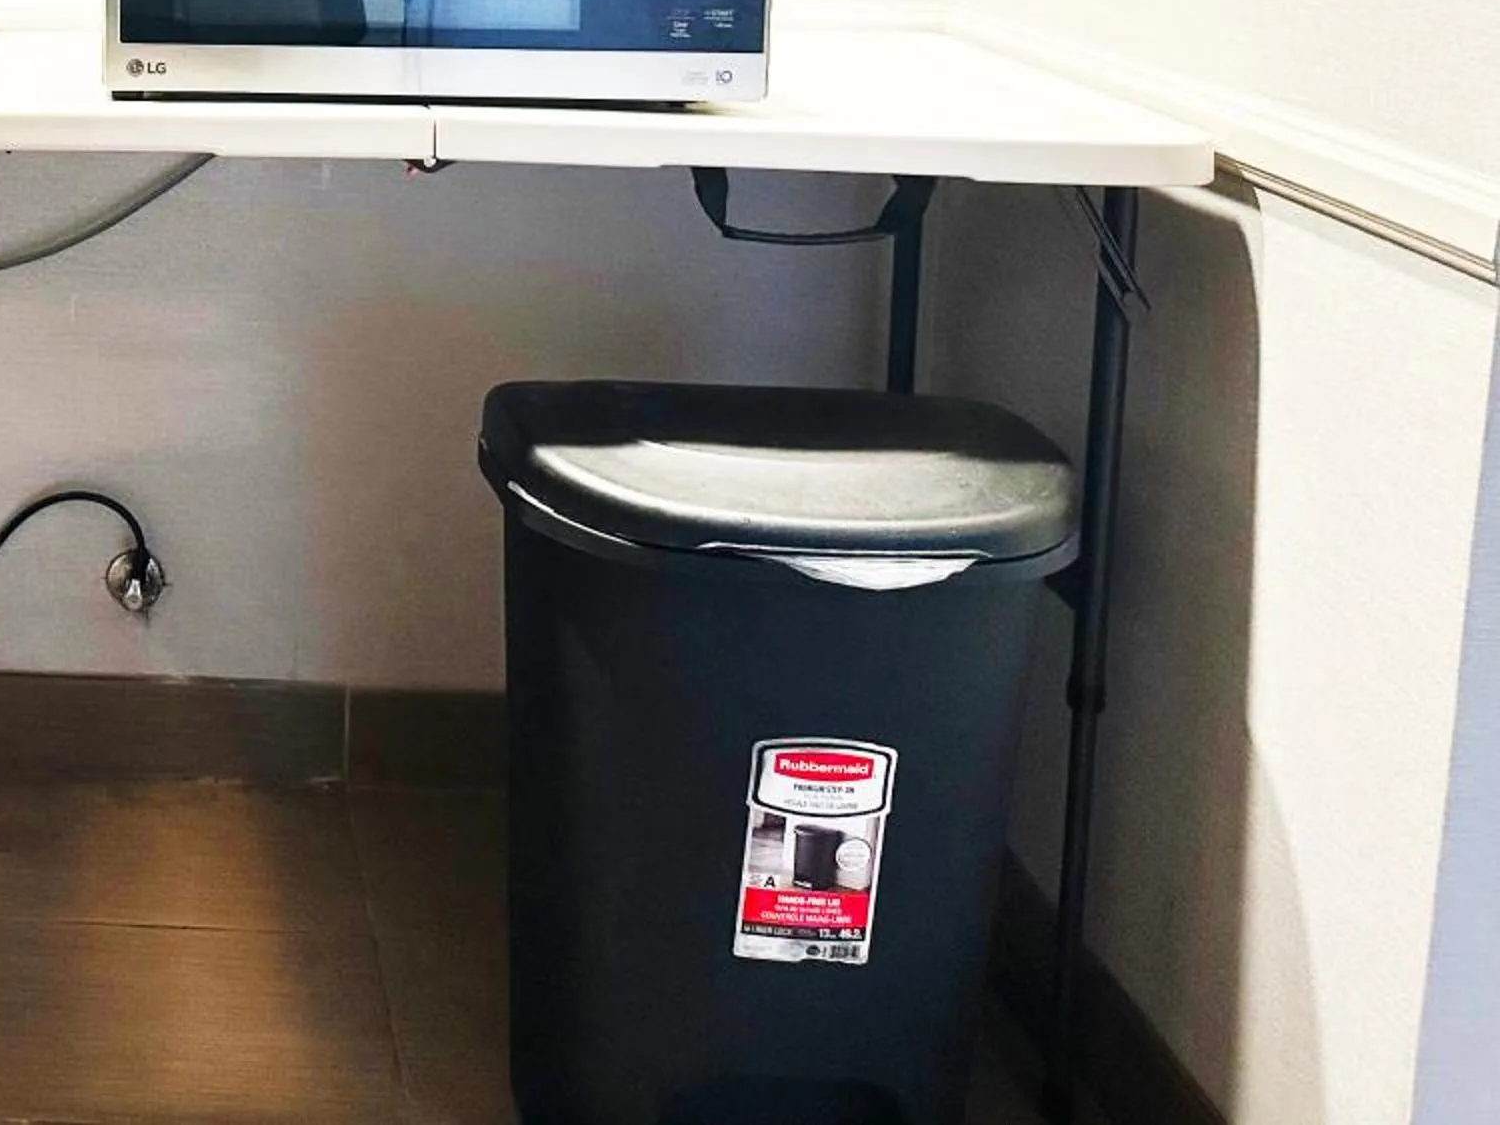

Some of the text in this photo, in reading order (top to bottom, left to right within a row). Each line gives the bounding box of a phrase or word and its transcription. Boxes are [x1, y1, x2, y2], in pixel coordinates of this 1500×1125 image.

[147, 62, 167, 75] LG
[780, 758, 869, 775] Rubbermaid
[764, 876, 776, 887] A
